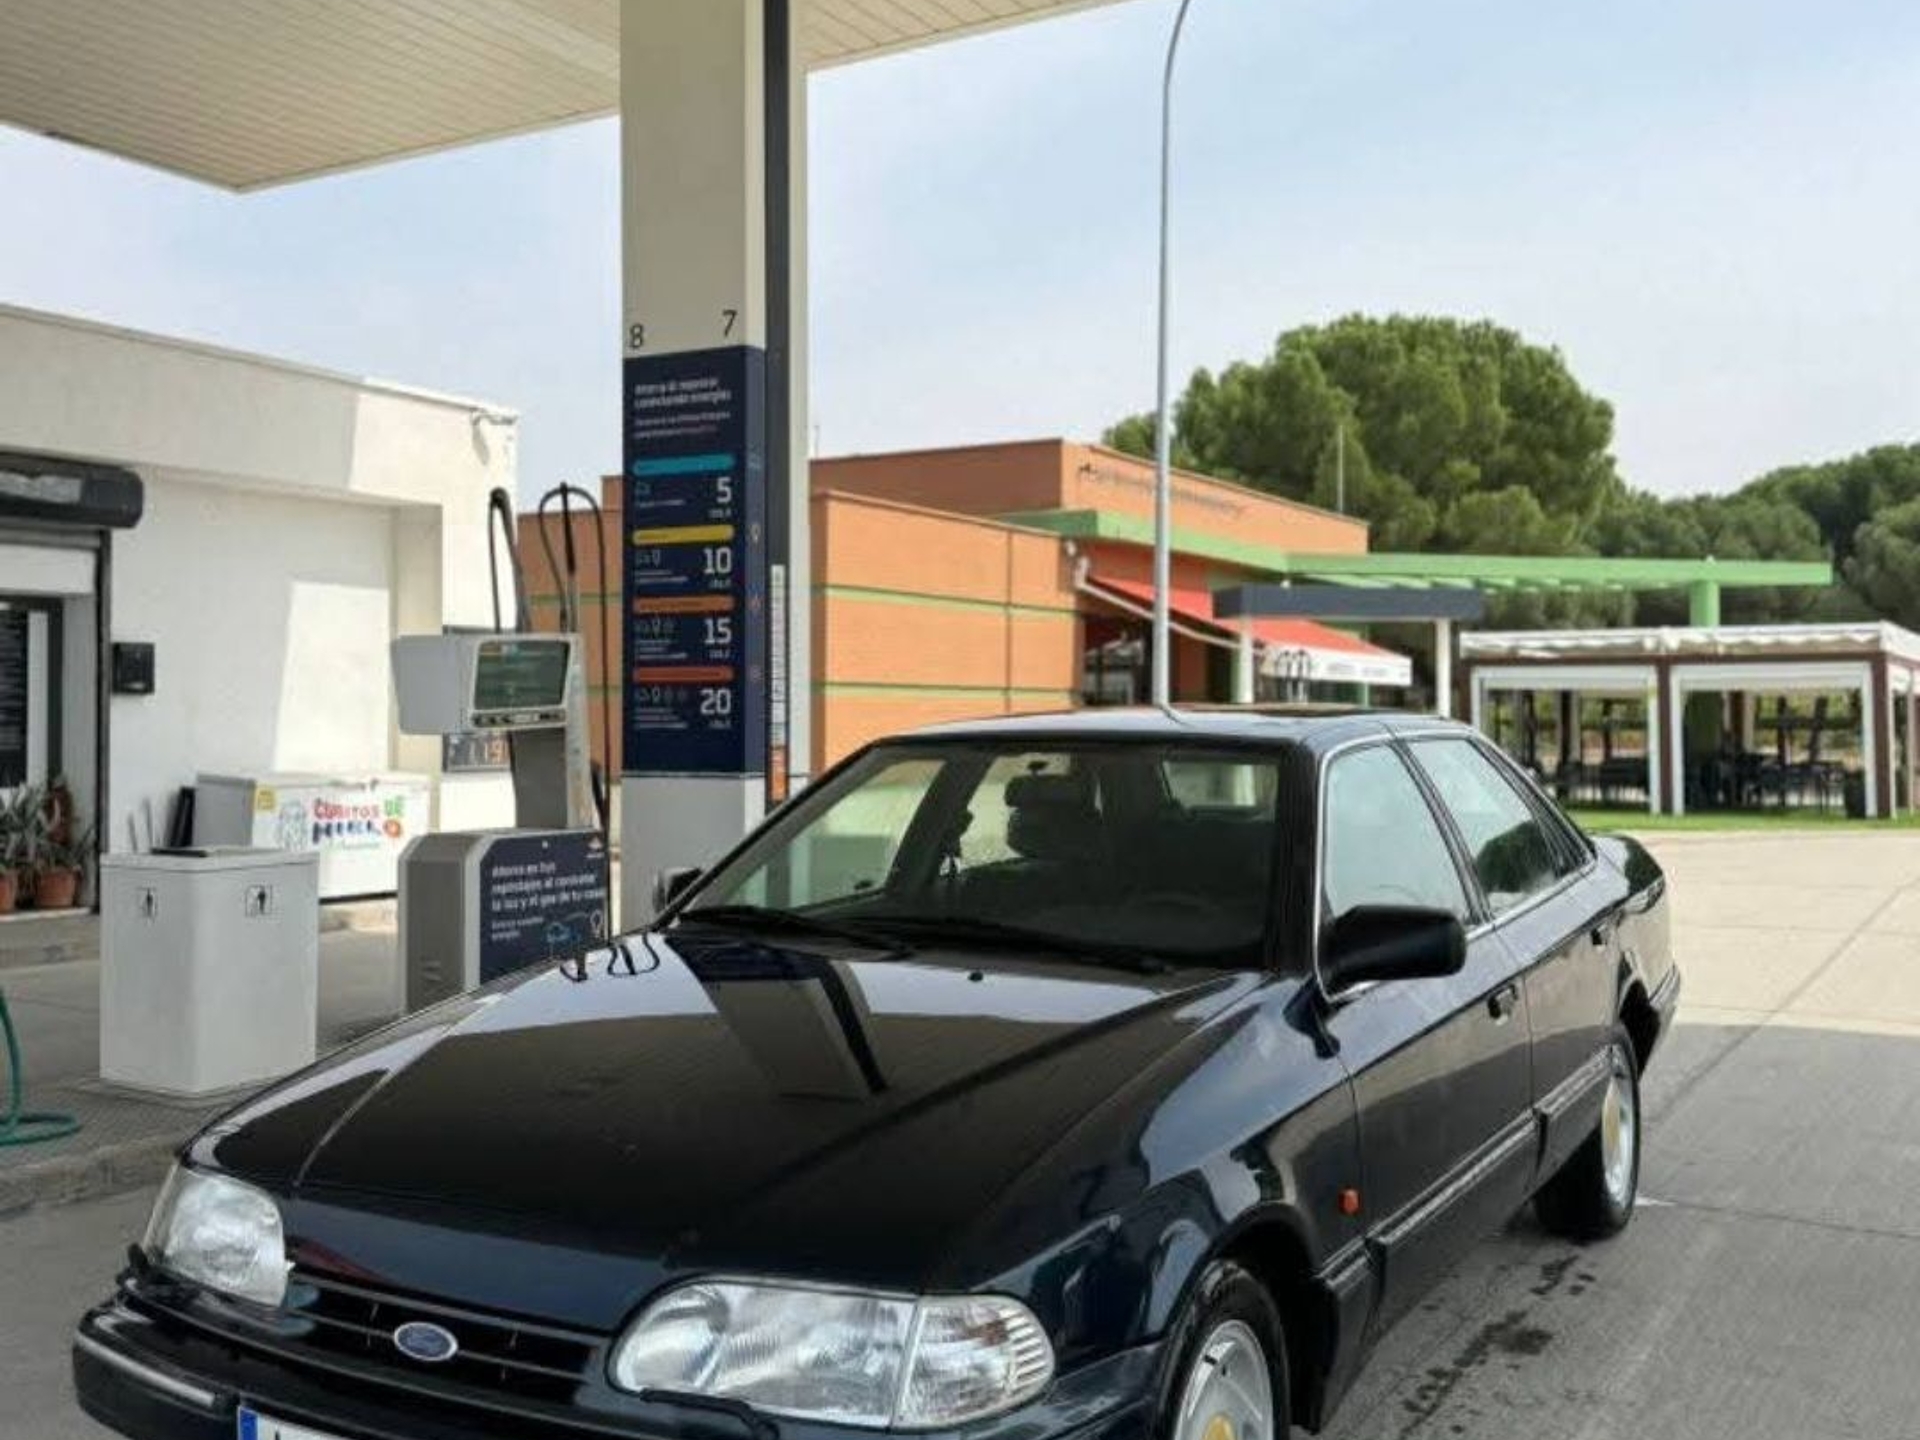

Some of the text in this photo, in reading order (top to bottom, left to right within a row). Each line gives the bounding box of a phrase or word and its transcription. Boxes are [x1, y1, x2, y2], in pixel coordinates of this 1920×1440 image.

[630, 324, 644, 348] 8
[722, 310, 737, 337] 7
[716, 477, 731, 504] 5
[703, 547, 731, 575] 10
[703, 618, 731, 645] 15
[700, 688, 731, 716] 20
